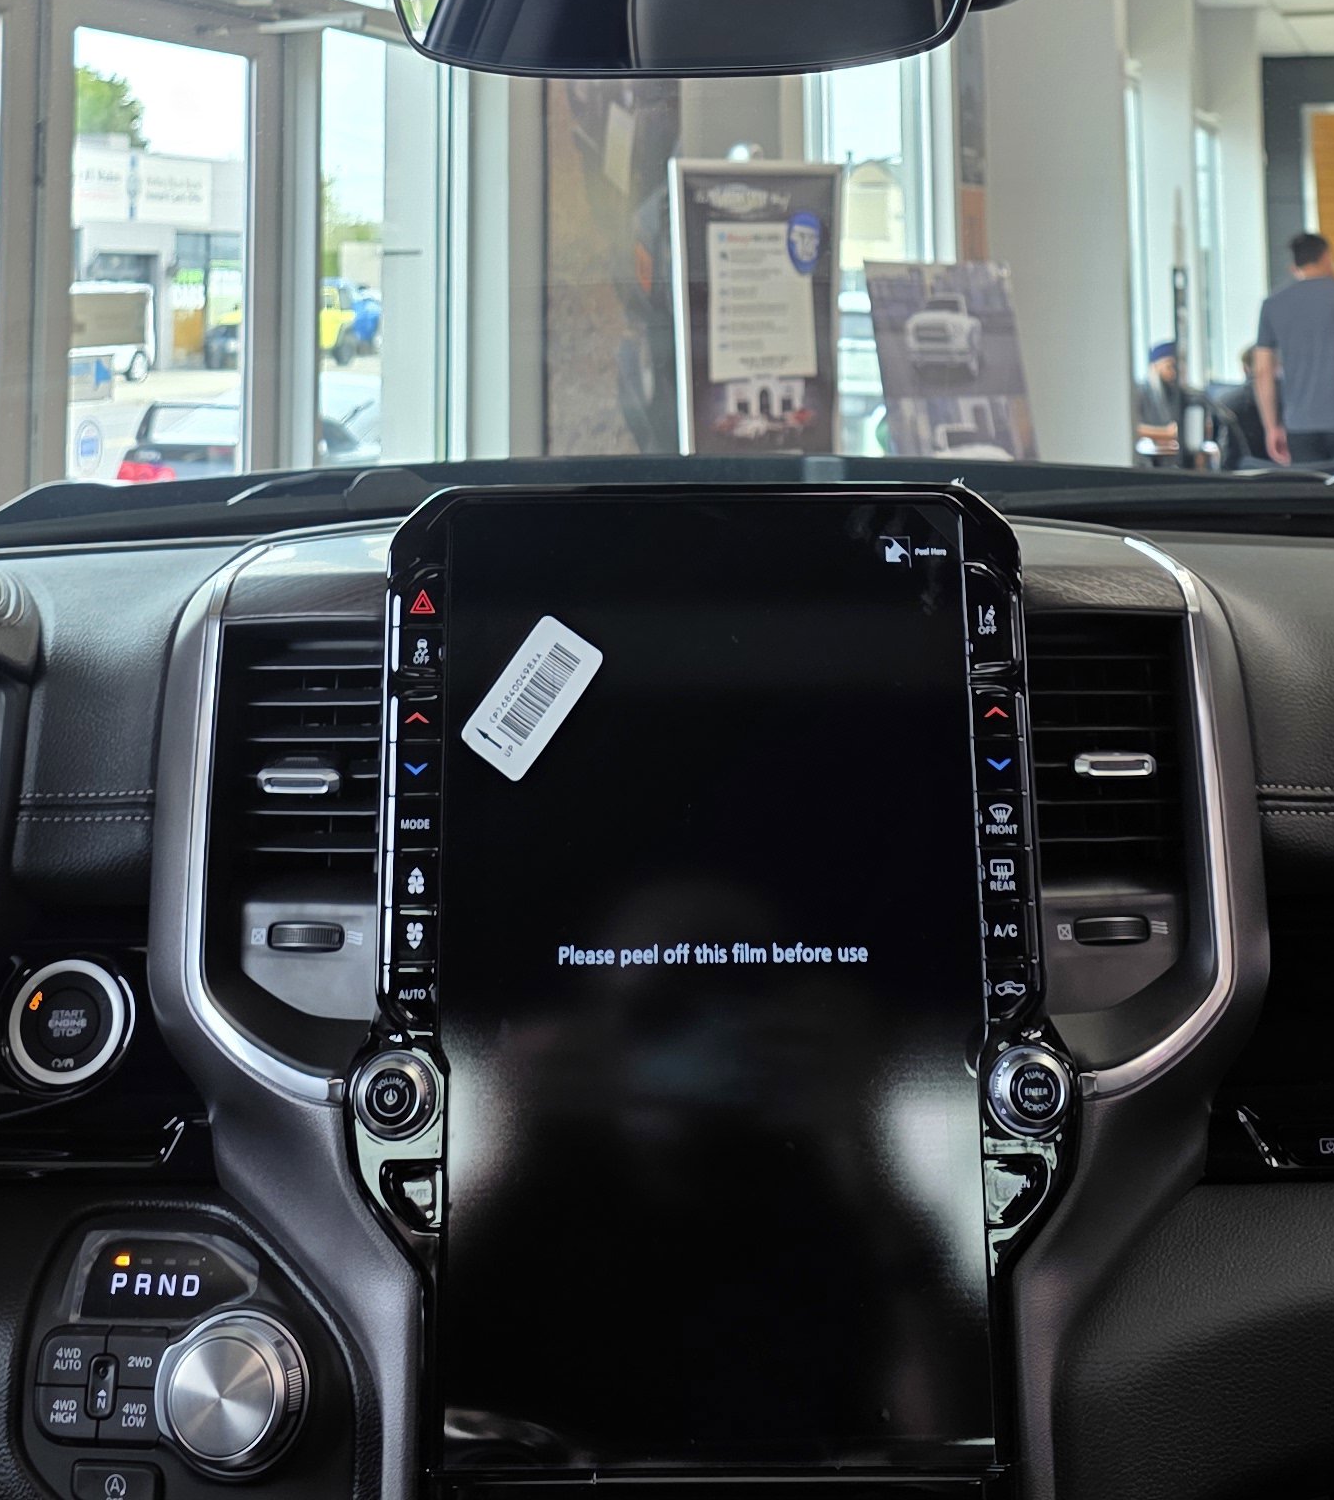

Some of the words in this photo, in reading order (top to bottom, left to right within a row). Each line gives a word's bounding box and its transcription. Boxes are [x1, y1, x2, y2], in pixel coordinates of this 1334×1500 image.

[978, 626, 997, 635] OFF
[413, 655, 430, 665] OFF
[504, 745, 515, 758] UP
[400, 818, 430, 830] MODE
[985, 824, 1018, 836] FRONT
[989, 880, 1016, 892] REAR
[993, 924, 1018, 938] A/C
[558, 944, 615, 966] Please
[620, 943, 659, 968] peel
[663, 943, 690, 964] off
[694, 943, 728, 964] this
[731, 942, 767, 964] film
[772, 942, 832, 964] before
[837, 946, 869, 963] use
[398, 988, 426, 1000] AUTO
[52, 1009, 85, 1018] START
[48, 1018, 87, 1029] ENGINE
[53, 1028, 82, 1038] STOP
[1024, 1071, 1047, 1081] TUNE
[375, 1076, 406, 1090] VOLUME
[1024, 1087, 1048, 1096] ENTER
[1022, 1100, 1052, 1113] SCROLL
[56, 1347, 82, 1359] 4WD
[53, 1359, 82, 1371] AUTO
[127, 1356, 153, 1369] 2WD
[52, 1400, 77, 1412] 4WD
[96, 1397, 106, 1409] N
[122, 1403, 147, 1415] 4WD
[50, 1411, 78, 1424] HIGH
[121, 1415, 147, 1428] LOW
